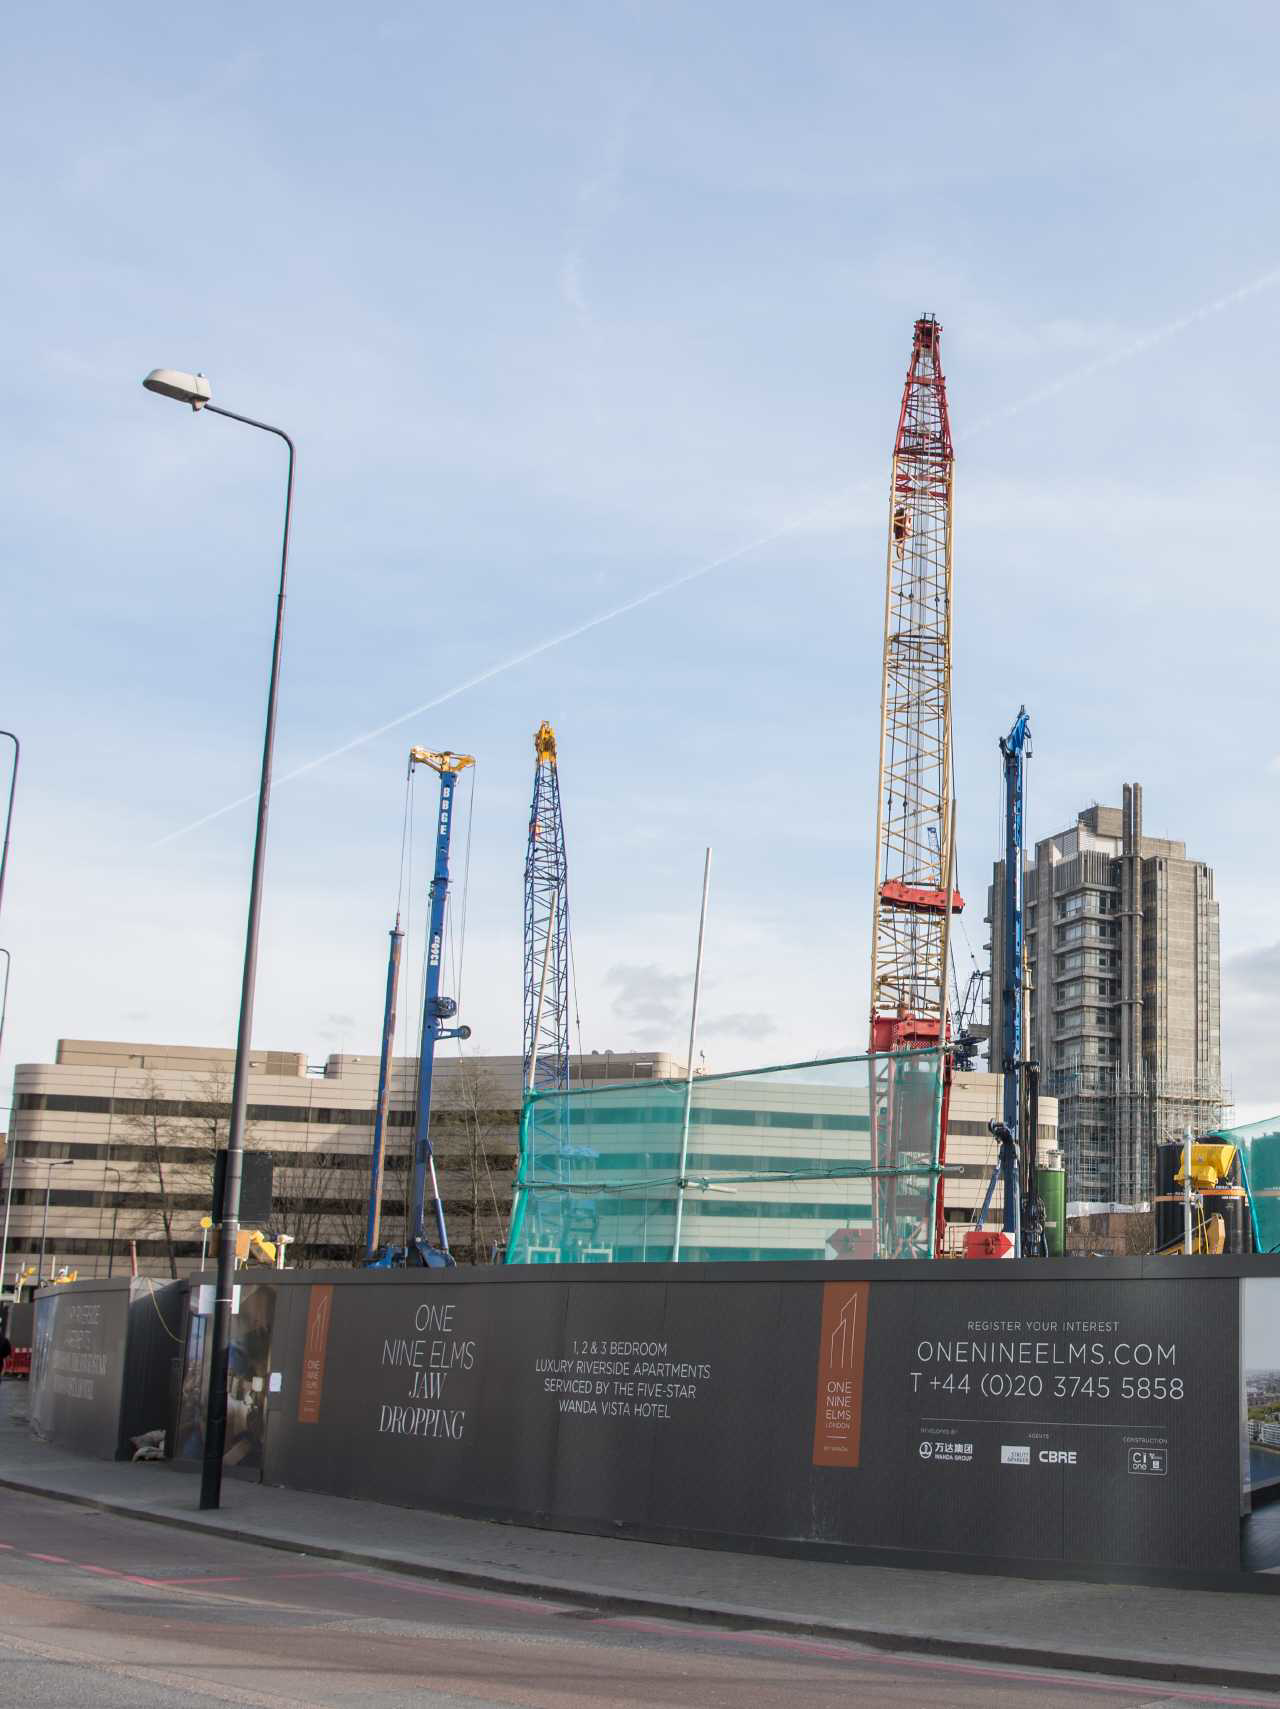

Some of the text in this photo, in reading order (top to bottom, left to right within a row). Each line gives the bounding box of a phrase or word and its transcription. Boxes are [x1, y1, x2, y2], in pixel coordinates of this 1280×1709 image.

[415, 1304, 456, 1332] ONE
[968, 1321, 1120, 1332] REGISTER YOUR INTEREST
[382, 1339, 476, 1370] NINE ELMS
[581, 1341, 588, 1354] 2
[590, 1342, 598, 1355] &
[600, 1342, 607, 1355] 3
[610, 1341, 667, 1356] BEDROOM
[917, 1341, 1176, 1366] ONENINEELMS.COM
[535, 1359, 712, 1379] LUXURY RIVERSIDE APARTMENTS
[408, 1373, 447, 1400] JAW
[544, 1378, 697, 1399] SERVICED BY THE FIVE-STAR
[827, 1381, 852, 1393] ONE
[911, 1372, 1184, 1400] T +44 (0)20 3745 5858
[558, 1400, 671, 1418] WANDA VISTA HOTEL
[826, 1395, 852, 1407] NINE
[378, 1405, 466, 1440] DROPPING
[825, 1409, 852, 1421] ELMS
[1039, 1451, 1077, 1464] CBRE
